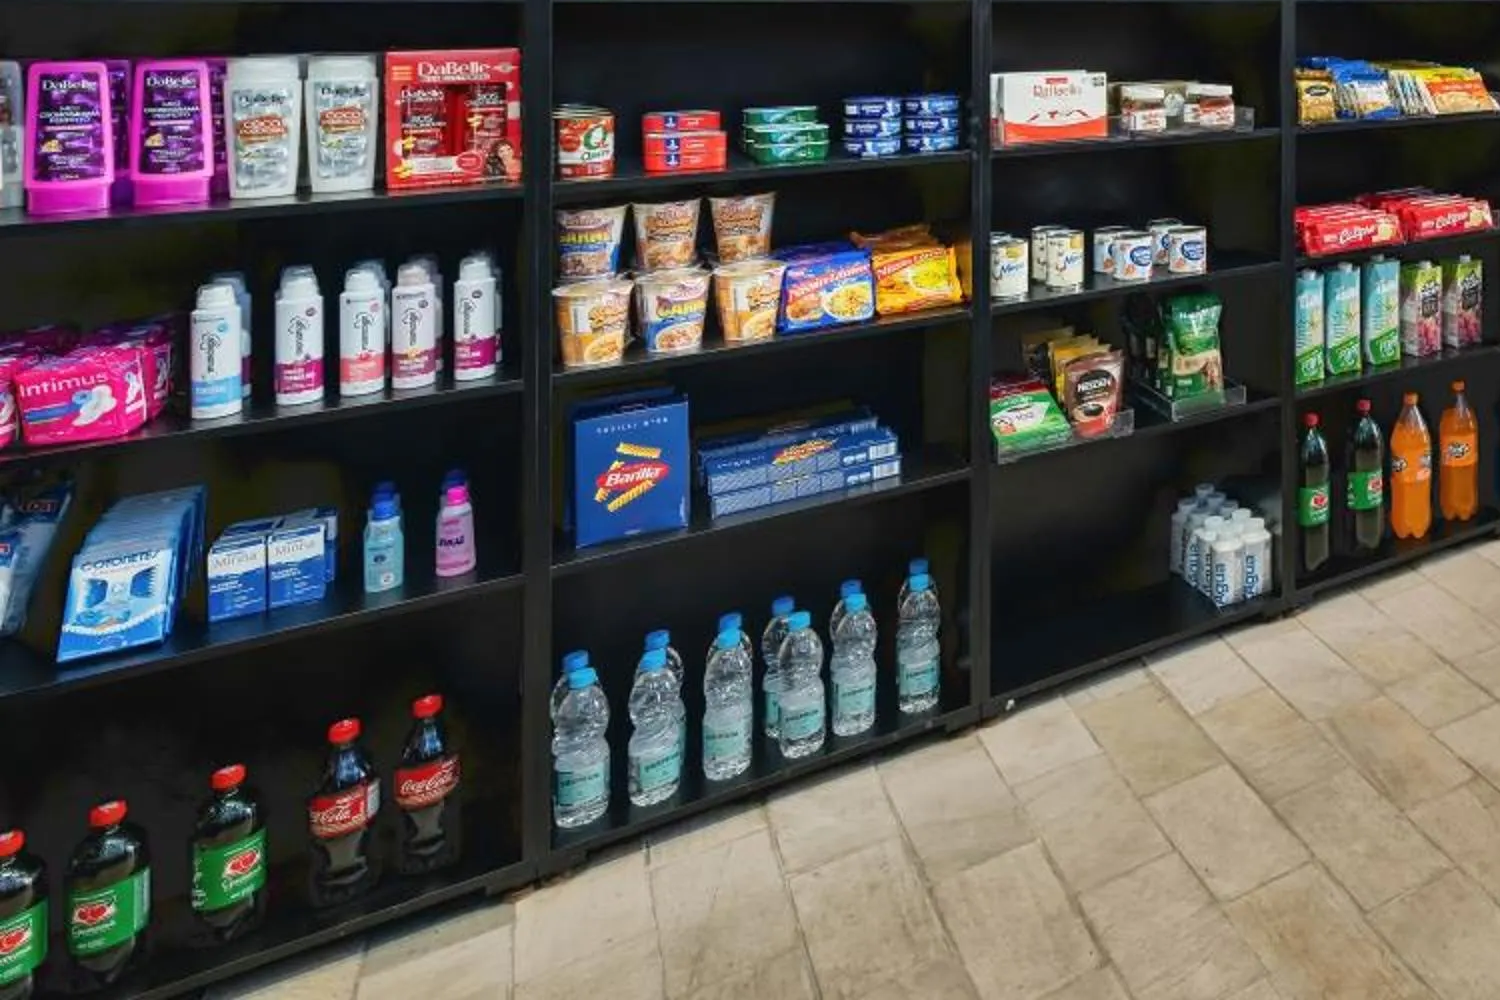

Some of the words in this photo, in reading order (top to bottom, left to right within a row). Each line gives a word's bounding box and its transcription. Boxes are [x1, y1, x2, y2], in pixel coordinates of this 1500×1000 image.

[417, 61, 491, 76] DaBelle
[19, 372, 109, 398] Intimus
[605, 466, 663, 487] Barilla
